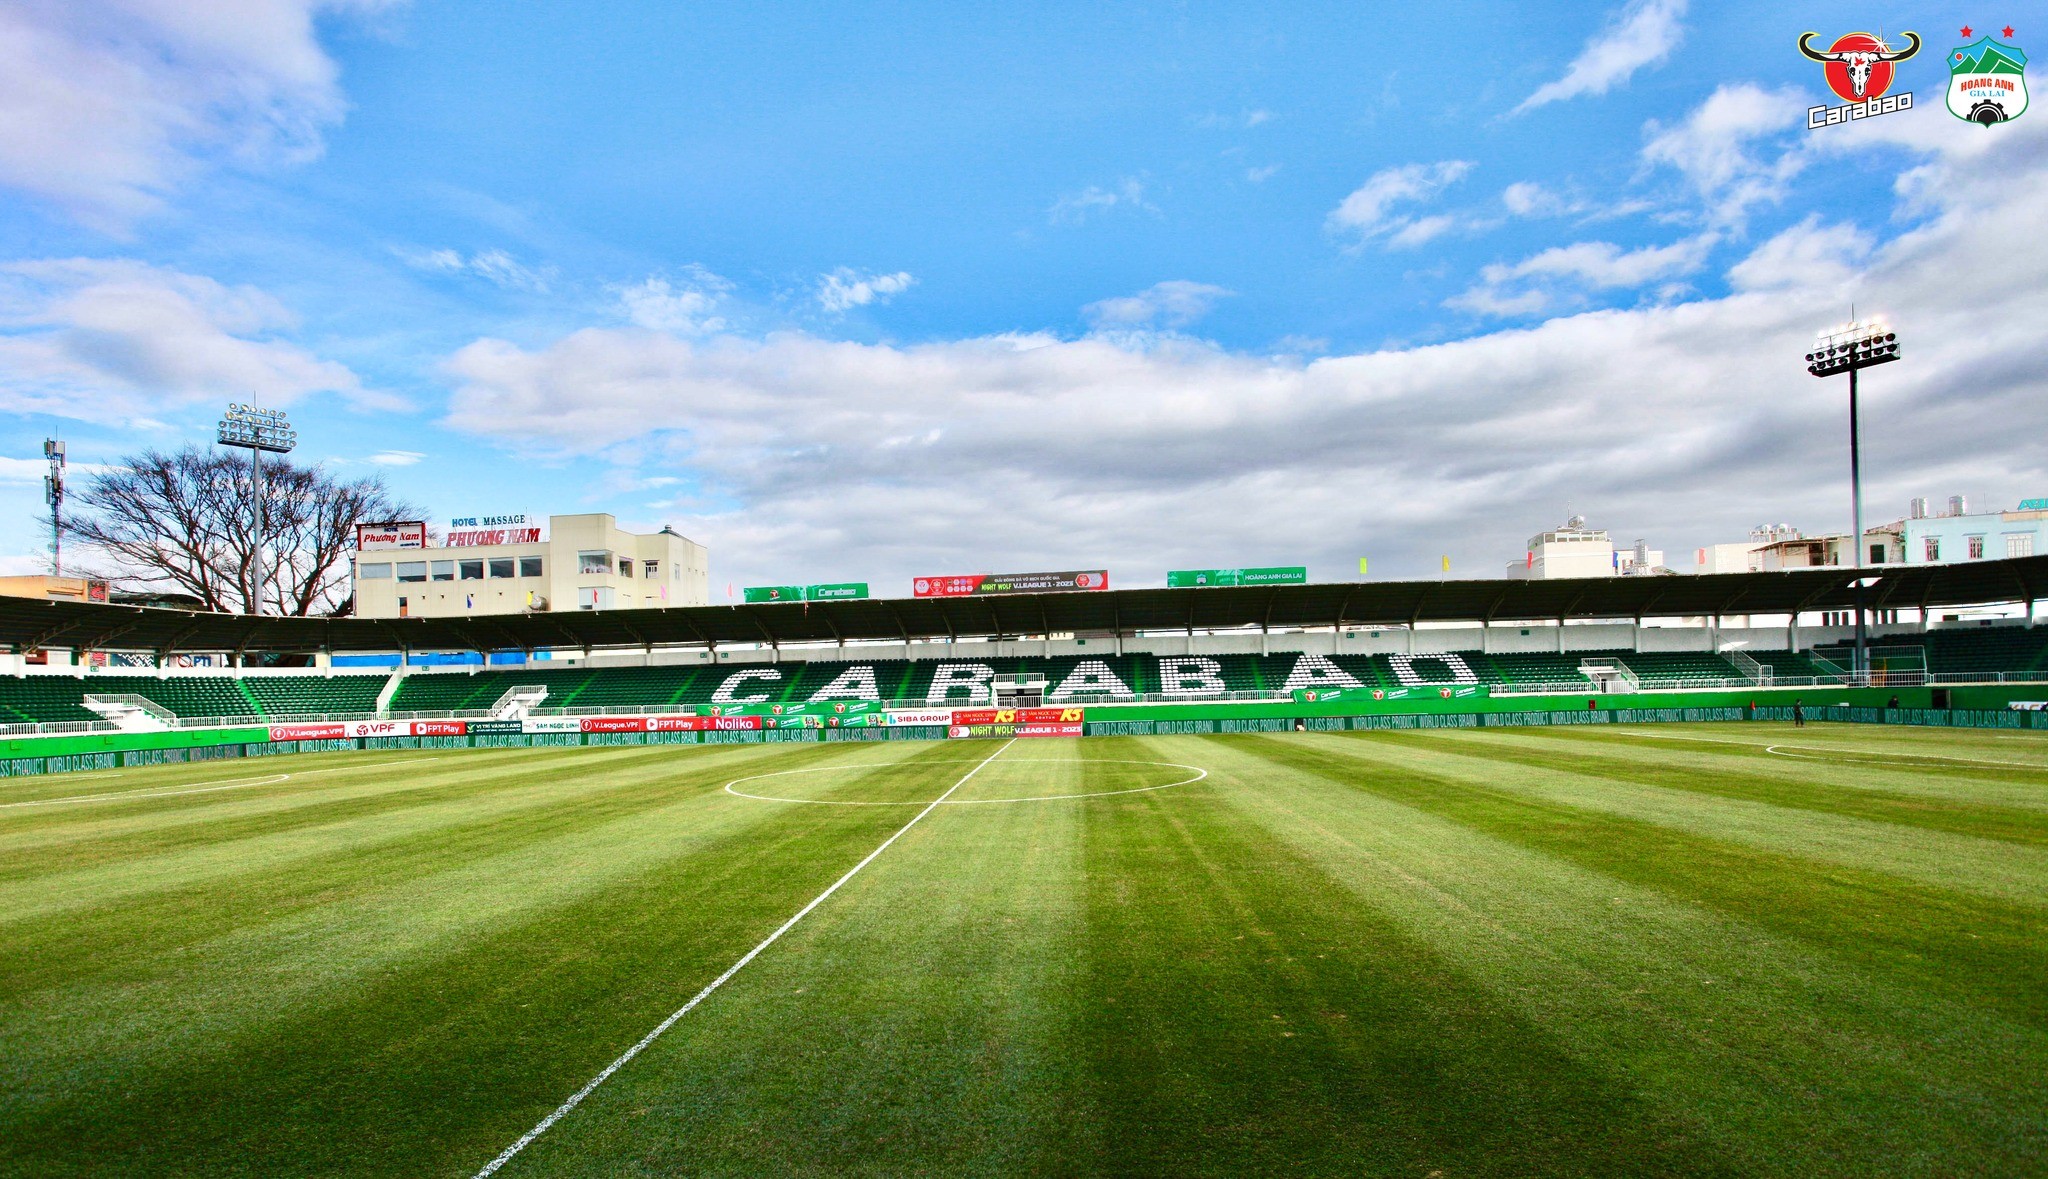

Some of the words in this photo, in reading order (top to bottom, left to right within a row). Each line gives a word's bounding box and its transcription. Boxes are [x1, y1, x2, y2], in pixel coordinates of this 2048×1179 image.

[452, 517, 478, 527] HOTEL
[483, 514, 526, 526] MASSAGE
[400, 532, 420, 540] Nam
[507, 528, 540, 543] NAM
[981, 583, 996, 591] NIGHT
[711, 653, 1479, 704] CARABAO
[994, 710, 1017, 723] K5
[1060, 708, 1083, 722] K5
[1483, 713, 1504, 727] WORLD
[1505, 713, 1523, 726] CLASS
[1523, 712, 1548, 726] PRODUCT
[1551, 711, 1571, 725] WORLD
[1571, 711, 1590, 724] CLASS
[1590, 710, 1610, 724] BRAND
[1616, 709, 1637, 723] WORLD
[1637, 709, 1656, 722] CLASS
[1656, 709, 1682, 722] PRODUCT
[1683, 708, 1704, 721] WORLD
[1705, 707, 1723, 721] CLASS
[1724, 707, 1743, 720] BRAND
[1751, 706, 1774, 720] WORLD
[1774, 706, 1794, 720] CLASS
[1885, 709, 1903, 723] WORLD
[1904, 709, 1922, 724] CLASS
[1923, 709, 1949, 725] PRODUCT
[1952, 710, 1974, 726] WORLD
[1976, 711, 1997, 727] CLASS
[1997, 711, 2021, 728] BRAND
[370, 723, 395, 732] VPF
[659, 720, 674, 728] FPT
[676, 720, 693, 729] Play
[715, 718, 753, 729] Noliko
[1156, 721, 1176, 734] WORLD
[1176, 721, 1194, 734] CLASS
[1195, 720, 1213, 733] BRAND
[1221, 720, 1240, 733] WORLD
[1241, 719, 1259, 733] CLASS
[1260, 719, 1285, 732] PRODUCT
[1308, 718, 1326, 731] CLASS
[1326, 717, 1345, 731] BRAND
[1352, 716, 1372, 730] WORLD
[1373, 716, 1391, 730] CLASS
[1391, 715, 1417, 729] PRODUCT
[1420, 715, 1439, 728] WORLD
[1440, 714, 1458, 728] CLASS
[1458, 714, 1477, 727] BRAND
[443, 725, 460, 734] Play
[970, 726, 992, 735] NIGHT
[995, 725, 1015, 735] WOLF
[1090, 723, 1109, 736] WORLD
[1110, 722, 1128, 736] CLASS
[1129, 721, 1154, 735] PRODUCT
[704, 731, 722, 743] WORLD
[723, 730, 740, 743] CLASS
[740, 730, 763, 743] PRODUCT
[765, 729, 783, 743] WORLD
[783, 729, 800, 742] CLASS
[801, 729, 818, 742] BRAND
[299, 740, 319, 752] WORLD
[320, 739, 336, 751] CLASS
[12, 758, 43, 776] PRODUCT
[47, 756, 71, 773] WORLD
[72, 754, 94, 771] CLASS
[94, 752, 116, 769] BRAND
